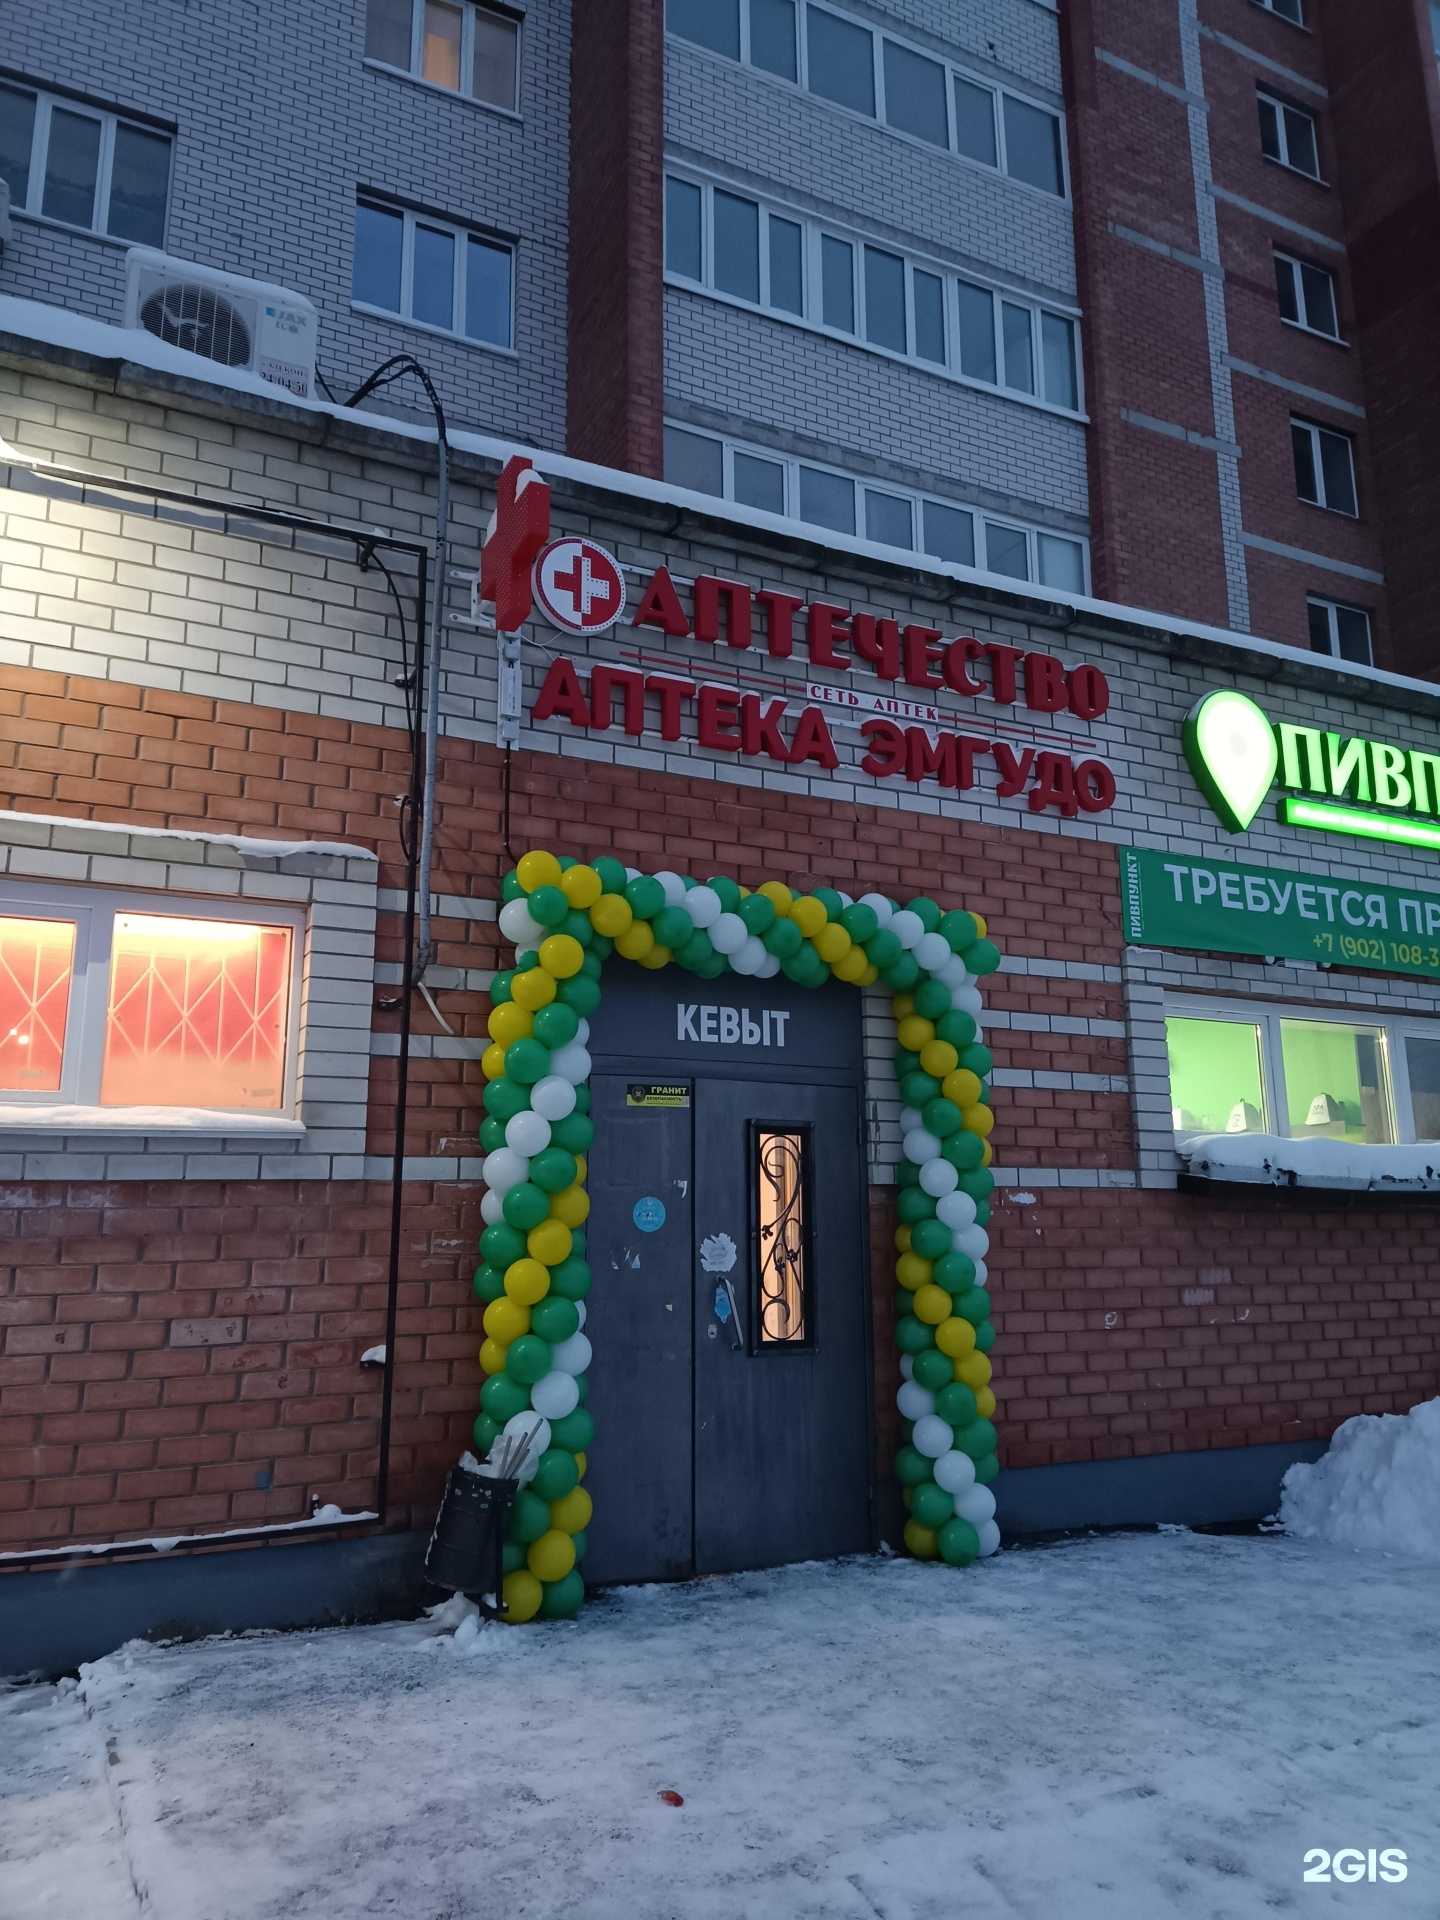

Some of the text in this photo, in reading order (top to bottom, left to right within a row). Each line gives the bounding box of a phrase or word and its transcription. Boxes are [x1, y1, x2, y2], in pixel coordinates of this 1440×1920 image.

[632, 564, 1110, 721] АПТЕЧЕСТВО
[532, 656, 1117, 817] АПТЕКА ЭМГУДО
[810, 685, 938, 721] СЕТЬ АПТЕК
[1277, 721, 1440, 816] ПИВП
[1126, 852, 1142, 938] ПИВПУНКТ
[1163, 863, 1389, 930] ТРЕБУЕТСЯ
[1312, 932, 1440, 967] +7 (902) 108-3
[676, 1002, 791, 1048] КЕВЫТ
[650, 1086, 688, 1095] ГРАНИТ
